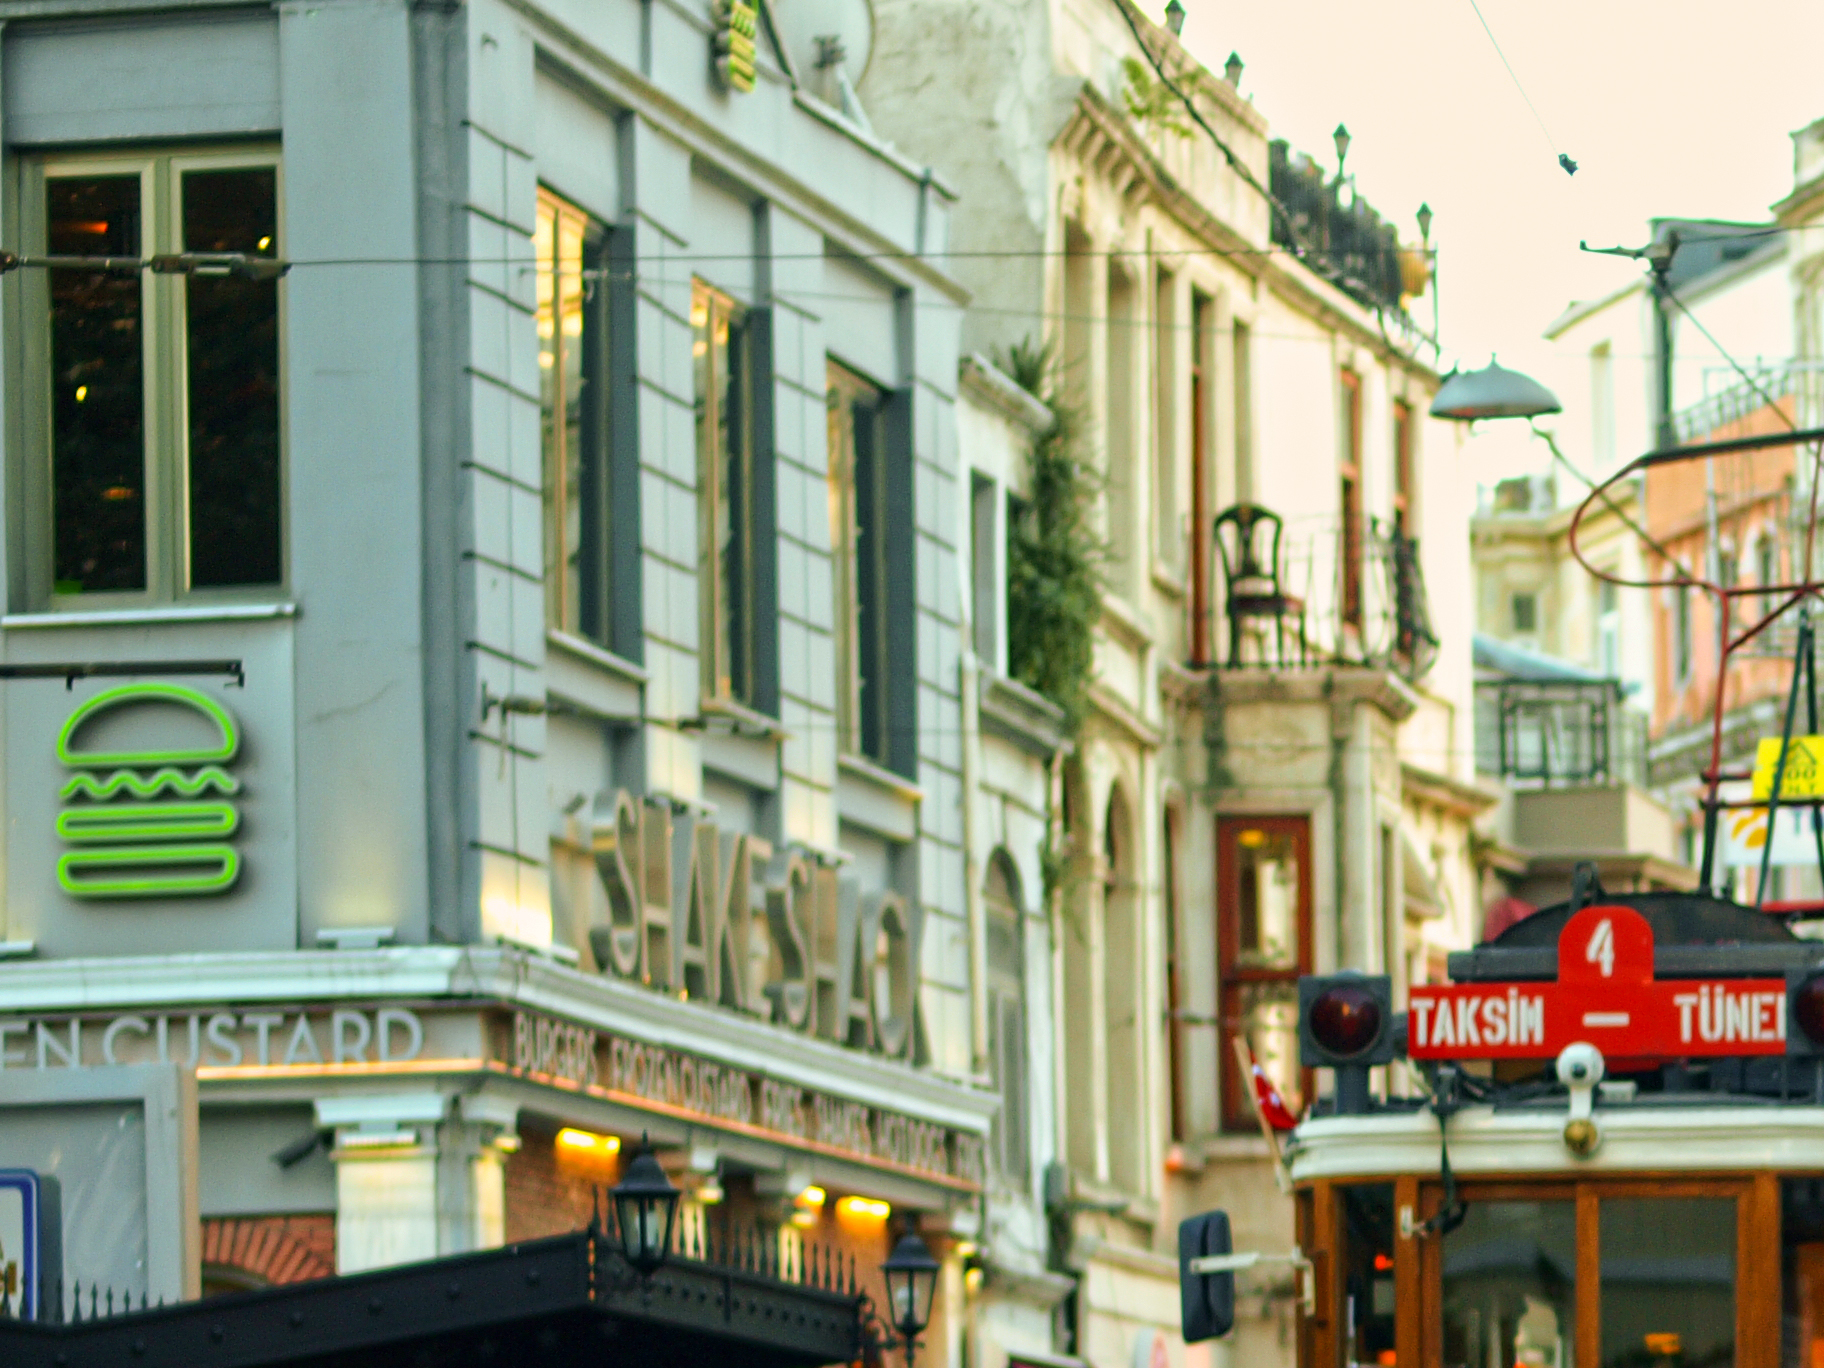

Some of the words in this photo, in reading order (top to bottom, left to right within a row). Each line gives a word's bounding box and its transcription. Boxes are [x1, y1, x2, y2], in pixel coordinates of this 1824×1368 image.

[1586, 917, 1615, 978] 4
[104, 1008, 425, 1068] CUSTARD
[1411, 986, 1545, 1046] TAKSİM
[514, 1010, 598, 1085] BURGERS
